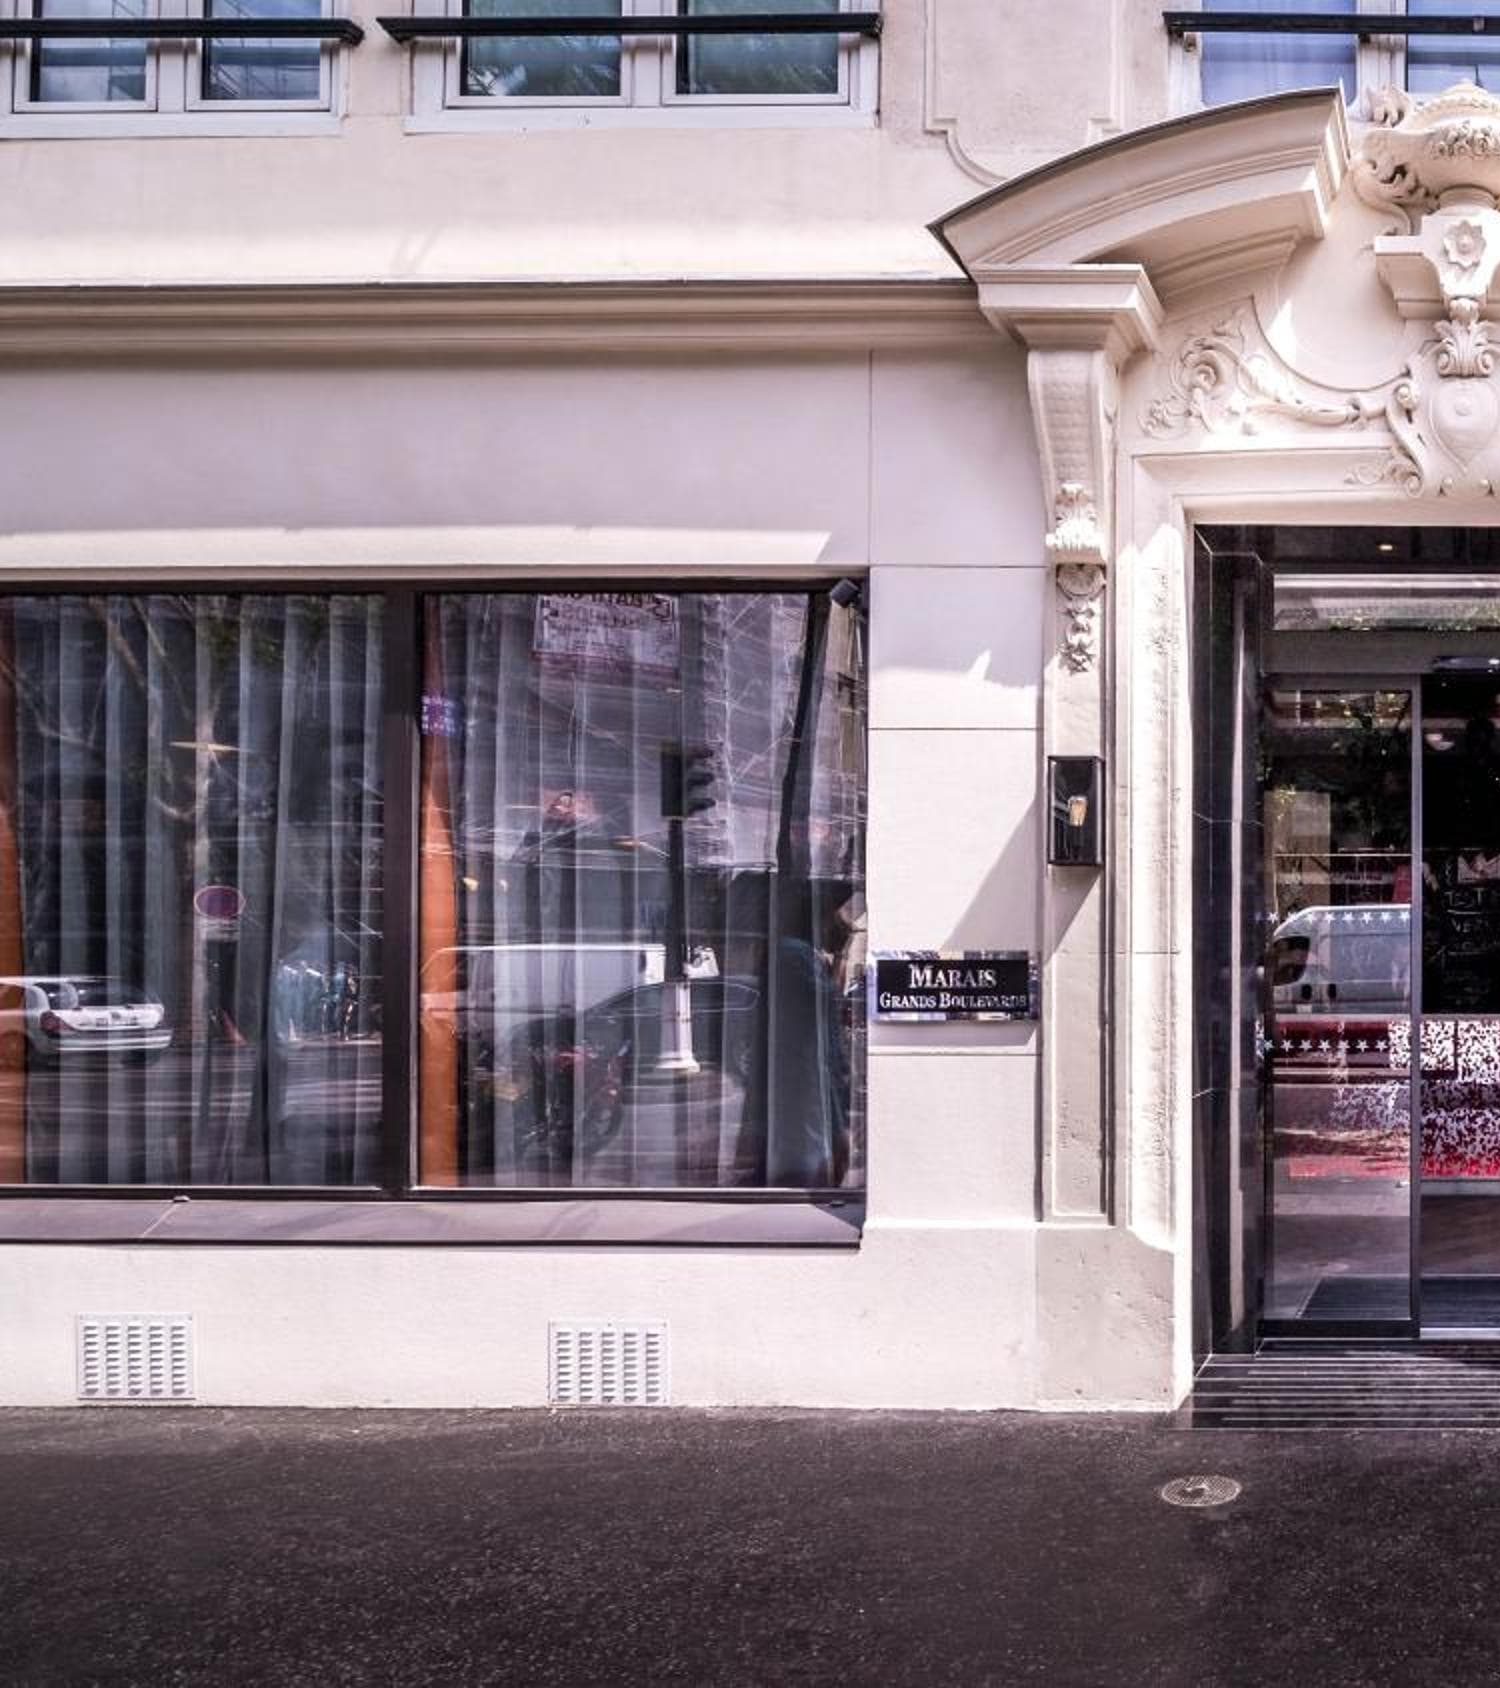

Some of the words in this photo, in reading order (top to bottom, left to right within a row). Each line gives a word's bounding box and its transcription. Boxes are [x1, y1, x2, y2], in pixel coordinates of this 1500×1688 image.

[909, 964, 997, 989] MARAIS
[879, 991, 937, 1009] GRANDS
[938, 992, 1027, 1009] BOULEVARDS
